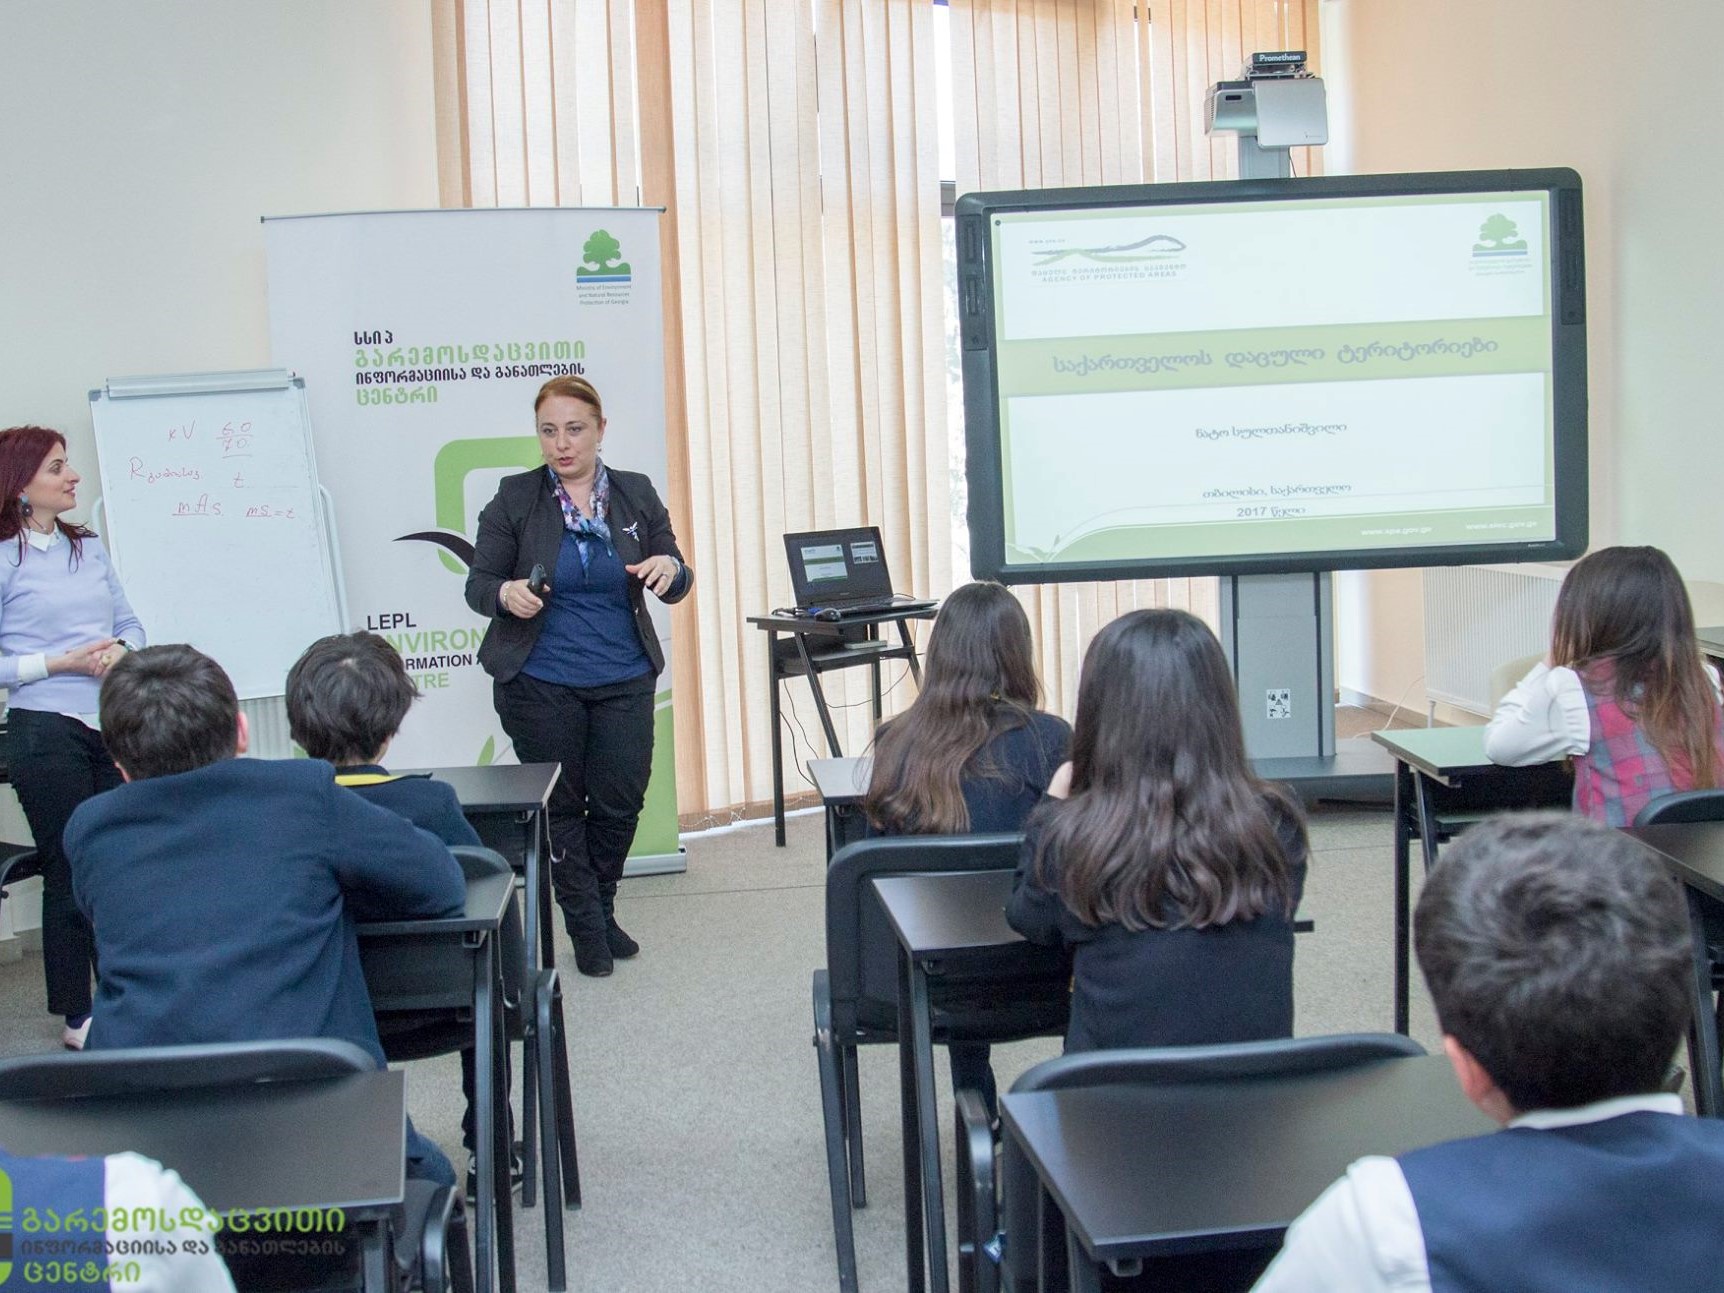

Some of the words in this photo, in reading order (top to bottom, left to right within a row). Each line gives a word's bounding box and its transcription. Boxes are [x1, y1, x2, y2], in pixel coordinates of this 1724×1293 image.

[1259, 54, 1301, 62] Promethean
[1042, 275, 1077, 283] AGENCY
[1094, 272, 1145, 281] PROTECTED
[1148, 270, 1177, 278] AREAS
[355, 340, 586, 368] გარემოსდაცვითი
[1053, 350, 1213, 377] საქართველოს
[1225, 347, 1325, 369] დაცული
[1337, 337, 1499, 364] ტერიტორიები
[355, 367, 467, 385] ინფორმაციისა
[470, 366, 491, 380] და
[495, 362, 585, 379] განათლების
[356, 385, 438, 406] ცენტრი
[1195, 427, 1229, 440] ნატო
[1270, 483, 1352, 497] საქართველო
[1236, 506, 1267, 518] 2017
[367, 613, 417, 631] LEPL
[405, 654, 473, 671] RMATION
